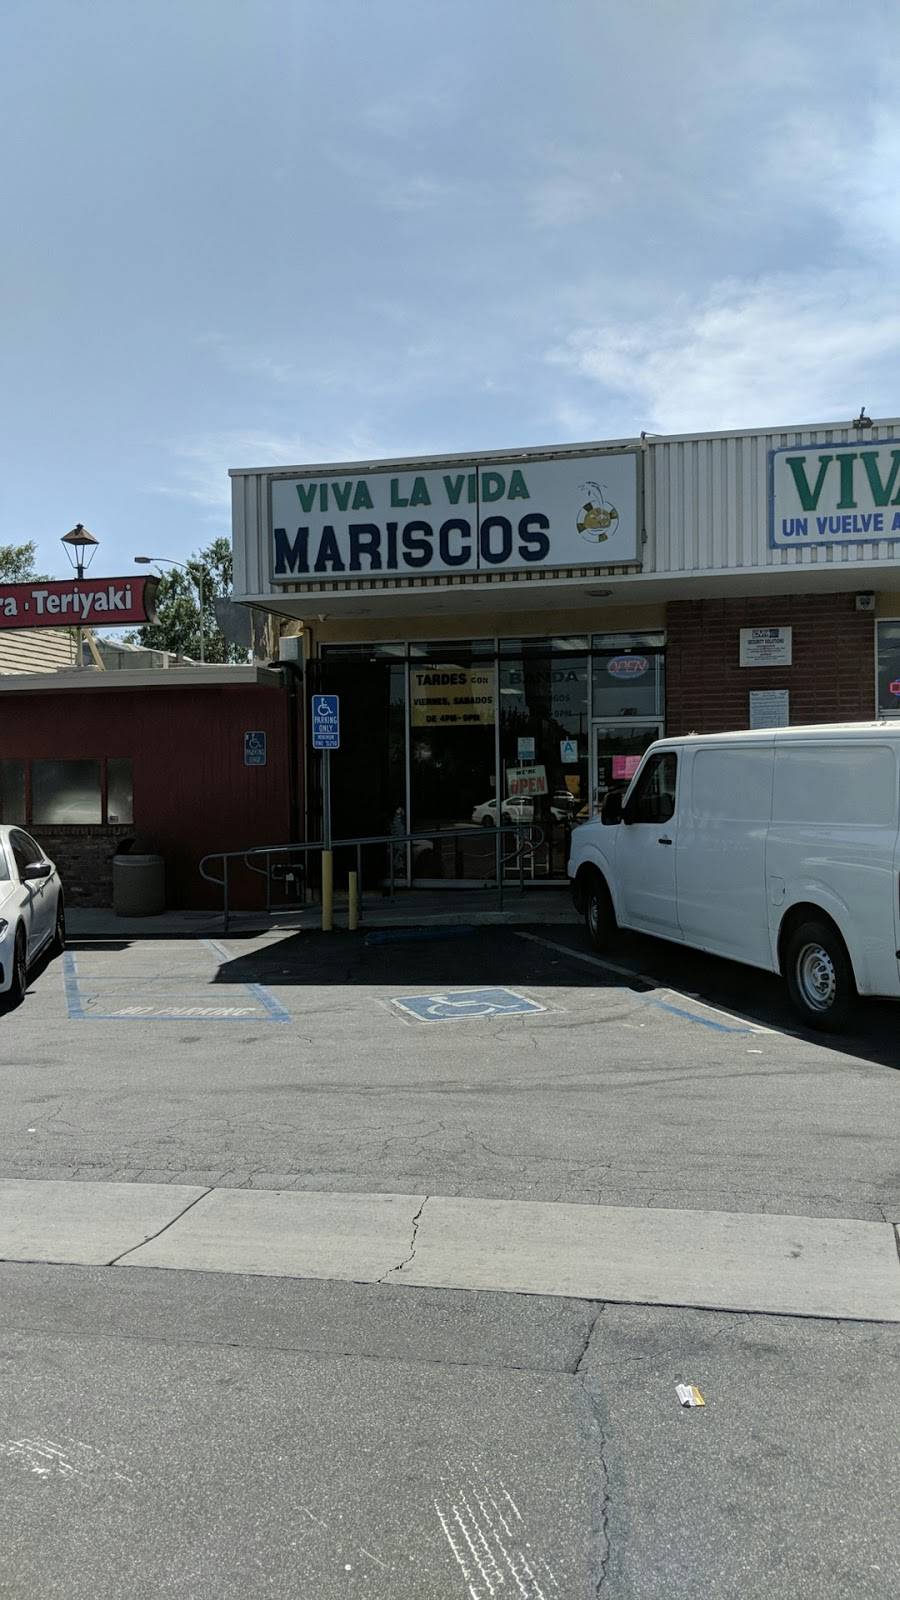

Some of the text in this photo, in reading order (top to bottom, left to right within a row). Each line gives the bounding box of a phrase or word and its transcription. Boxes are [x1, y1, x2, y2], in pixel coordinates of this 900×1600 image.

[785, 450, 900, 511] VIV
[296, 469, 531, 513] VIVA LA VIDA
[782, 517, 808, 536] UN
[816, 513, 883, 535] VUELVE
[274, 512, 551, 574] MARISCOS
[31, 584, 132, 619] Teriyaki
[415, 673, 467, 686] TARDES
[314, 716, 337, 724] PARKING
[319, 724, 333, 733] ONLY
[564, 743, 574, 752] A
[511, 776, 545, 794] OPEN
[111, 1006, 256, 1016] NO PARKING
